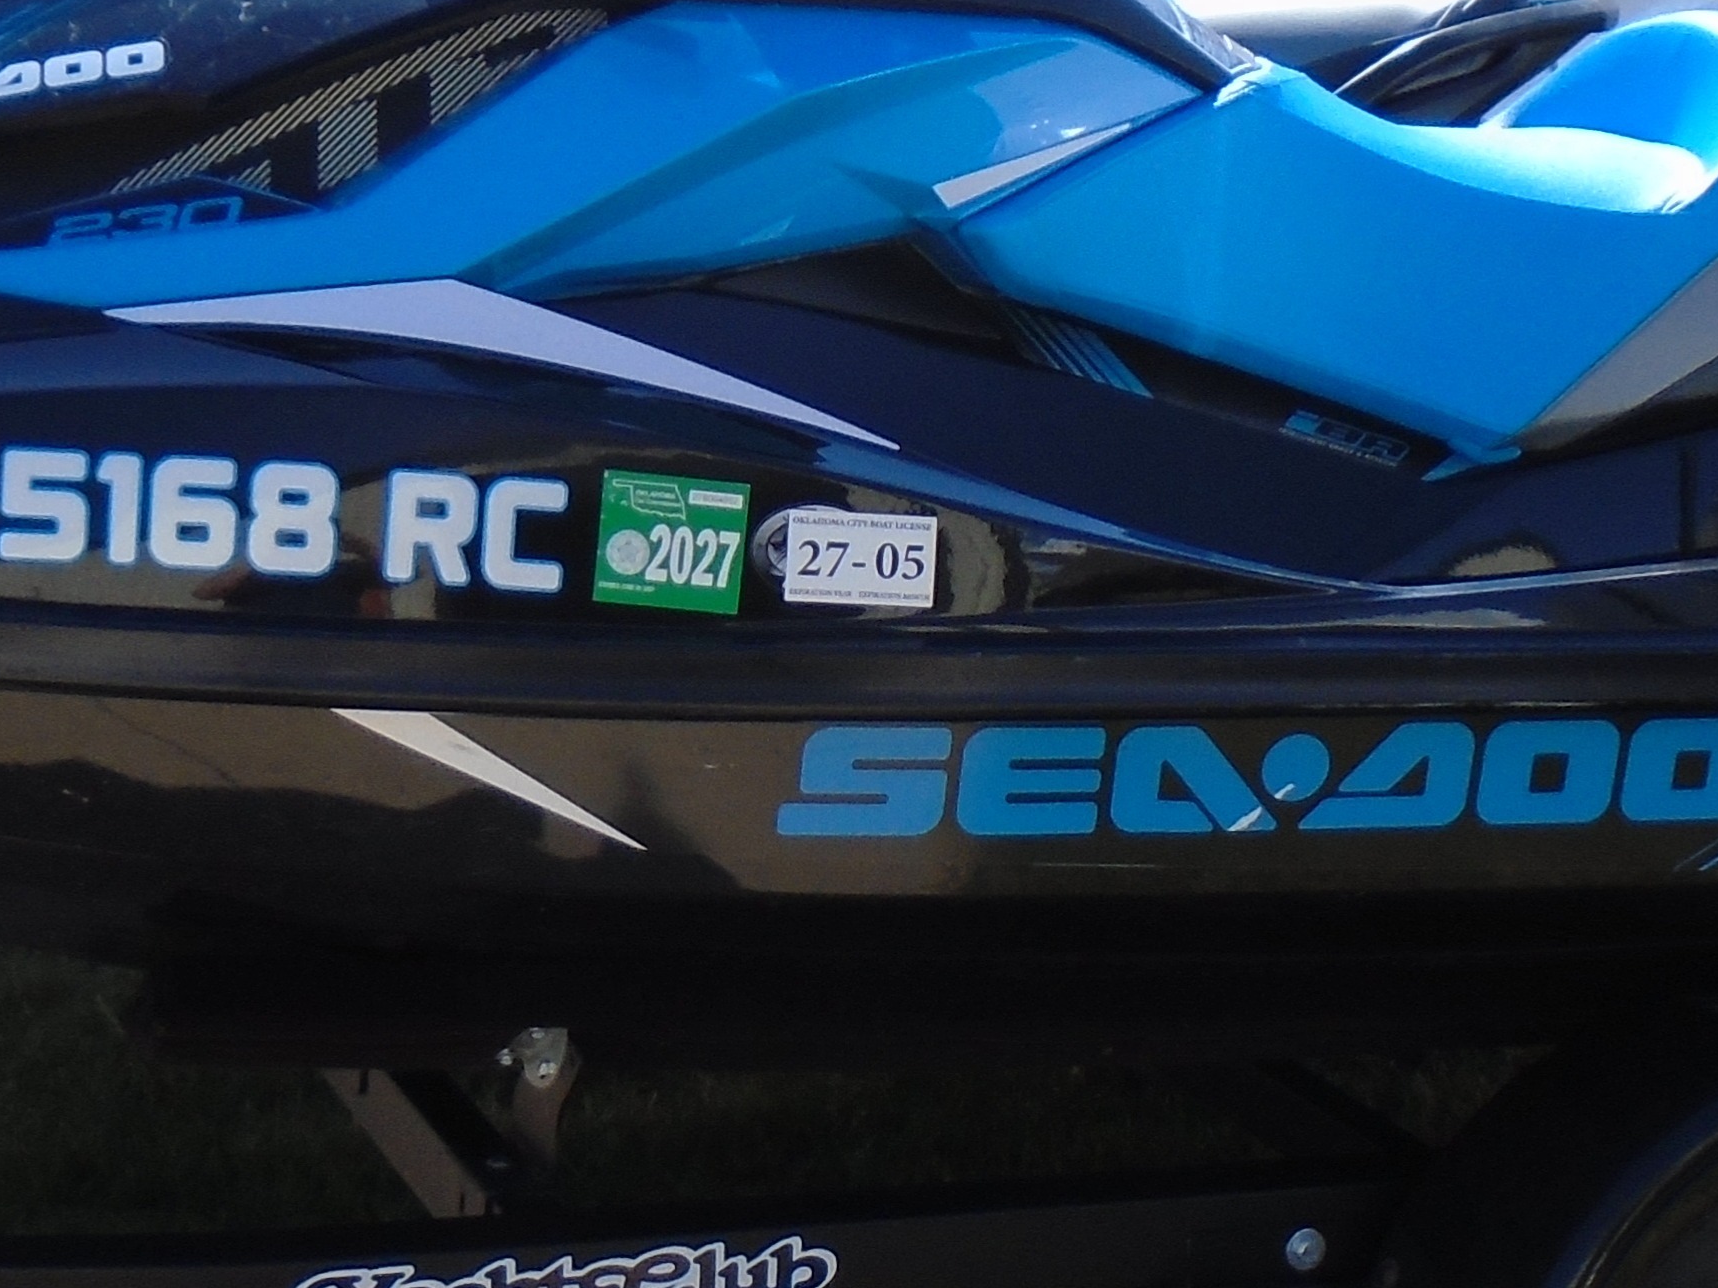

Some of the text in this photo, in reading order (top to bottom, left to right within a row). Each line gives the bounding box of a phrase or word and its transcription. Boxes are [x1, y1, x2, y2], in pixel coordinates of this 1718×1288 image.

[47, 195, 245, 248] 230
[382, 467, 571, 594] RC
[792, 515, 932, 532] OKLAHOMA CITY BOAT LICENSE
[645, 523, 741, 588] 2027
